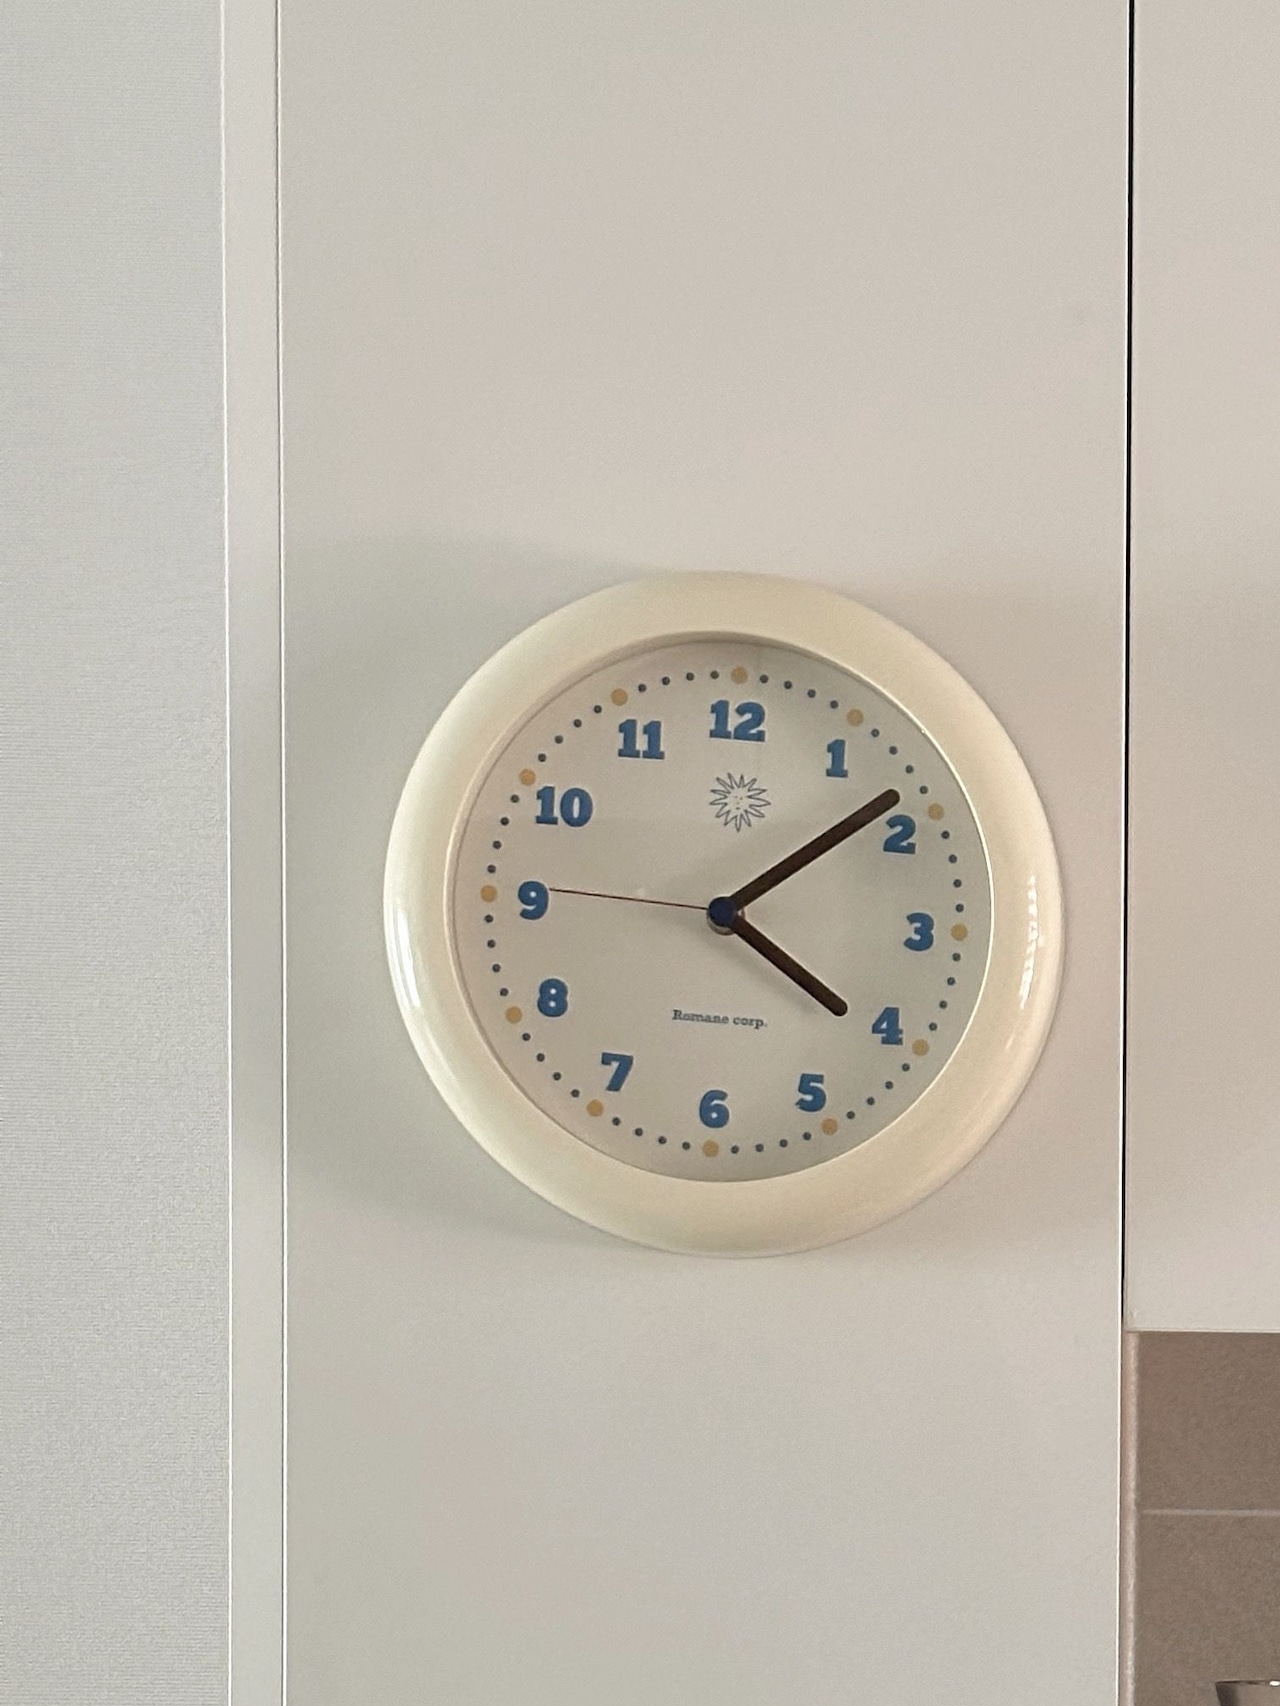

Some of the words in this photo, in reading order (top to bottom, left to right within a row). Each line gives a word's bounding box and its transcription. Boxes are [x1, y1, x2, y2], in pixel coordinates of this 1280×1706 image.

[618, 719, 665, 760] 11
[709, 700, 766, 742] 12
[827, 738, 848, 778] 1
[535, 786, 593, 827] 10
[883, 815, 917, 854] 2
[518, 881, 549, 920] 9
[903, 912, 935, 952] 3
[536, 978, 568, 1018] 8
[672, 1009, 730, 1024] Romane
[732, 1017, 768, 1030] corp.
[871, 1006, 904, 1046] 4
[600, 1052, 634, 1092] 7
[699, 1090, 730, 1128] 6
[796, 1073, 827, 1113] 5
